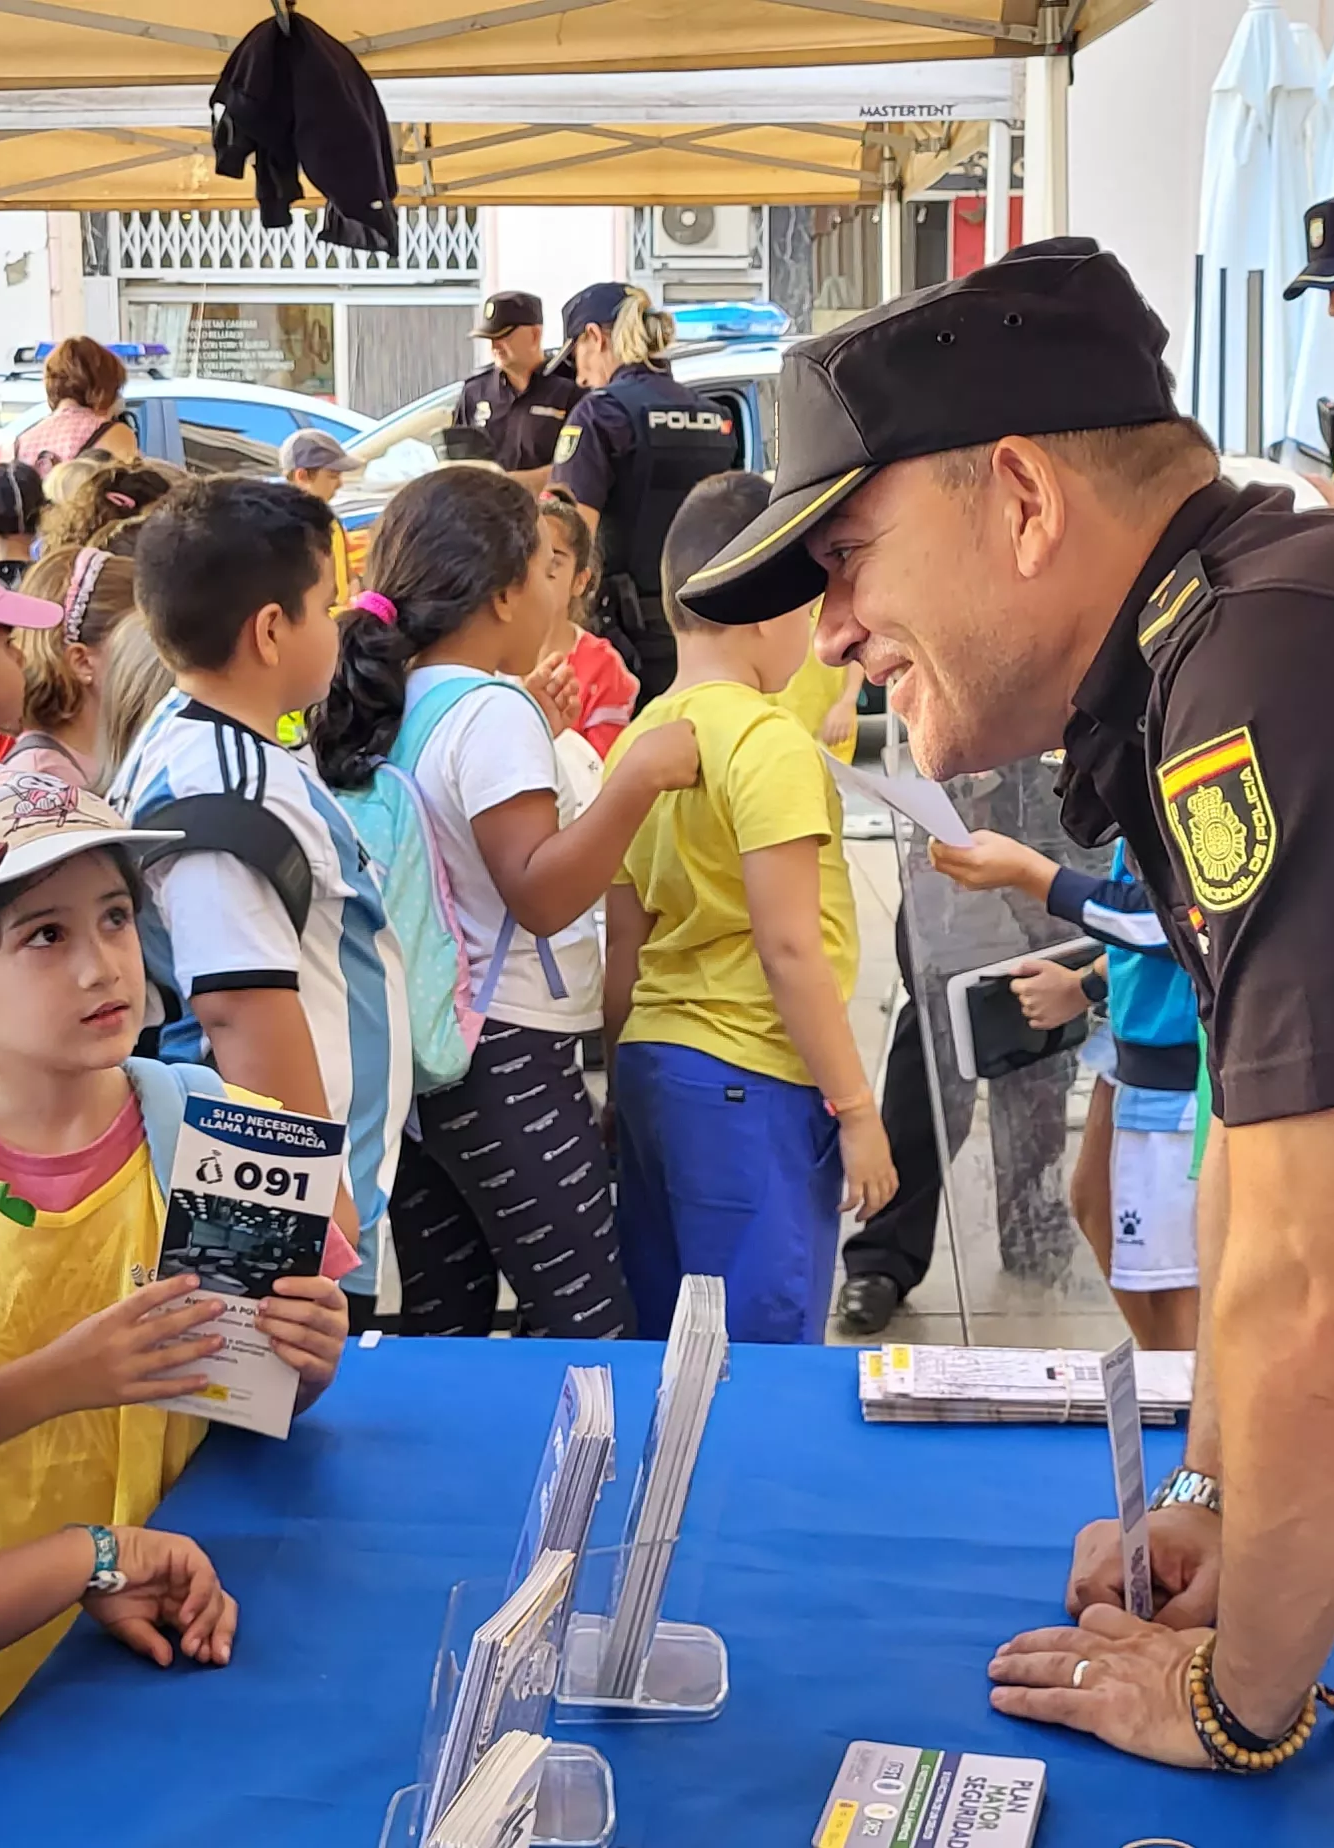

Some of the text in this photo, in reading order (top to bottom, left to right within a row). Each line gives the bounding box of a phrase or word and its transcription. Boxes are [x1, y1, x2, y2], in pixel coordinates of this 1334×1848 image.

[859, 104, 956, 117] MASTERTENT
[1248, 843, 1267, 873] DE
[199, 1117, 327, 1150] LLAMA A LA POLICÍA
[212, 1108, 318, 1138] SI LO NECESITAS,
[234, 1161, 310, 1201] 091
[946, 1775, 987, 1848] SEGURIDAD
[975, 1784, 1009, 1830] MAYOR
[1005, 1780, 1034, 1813] PLAN
